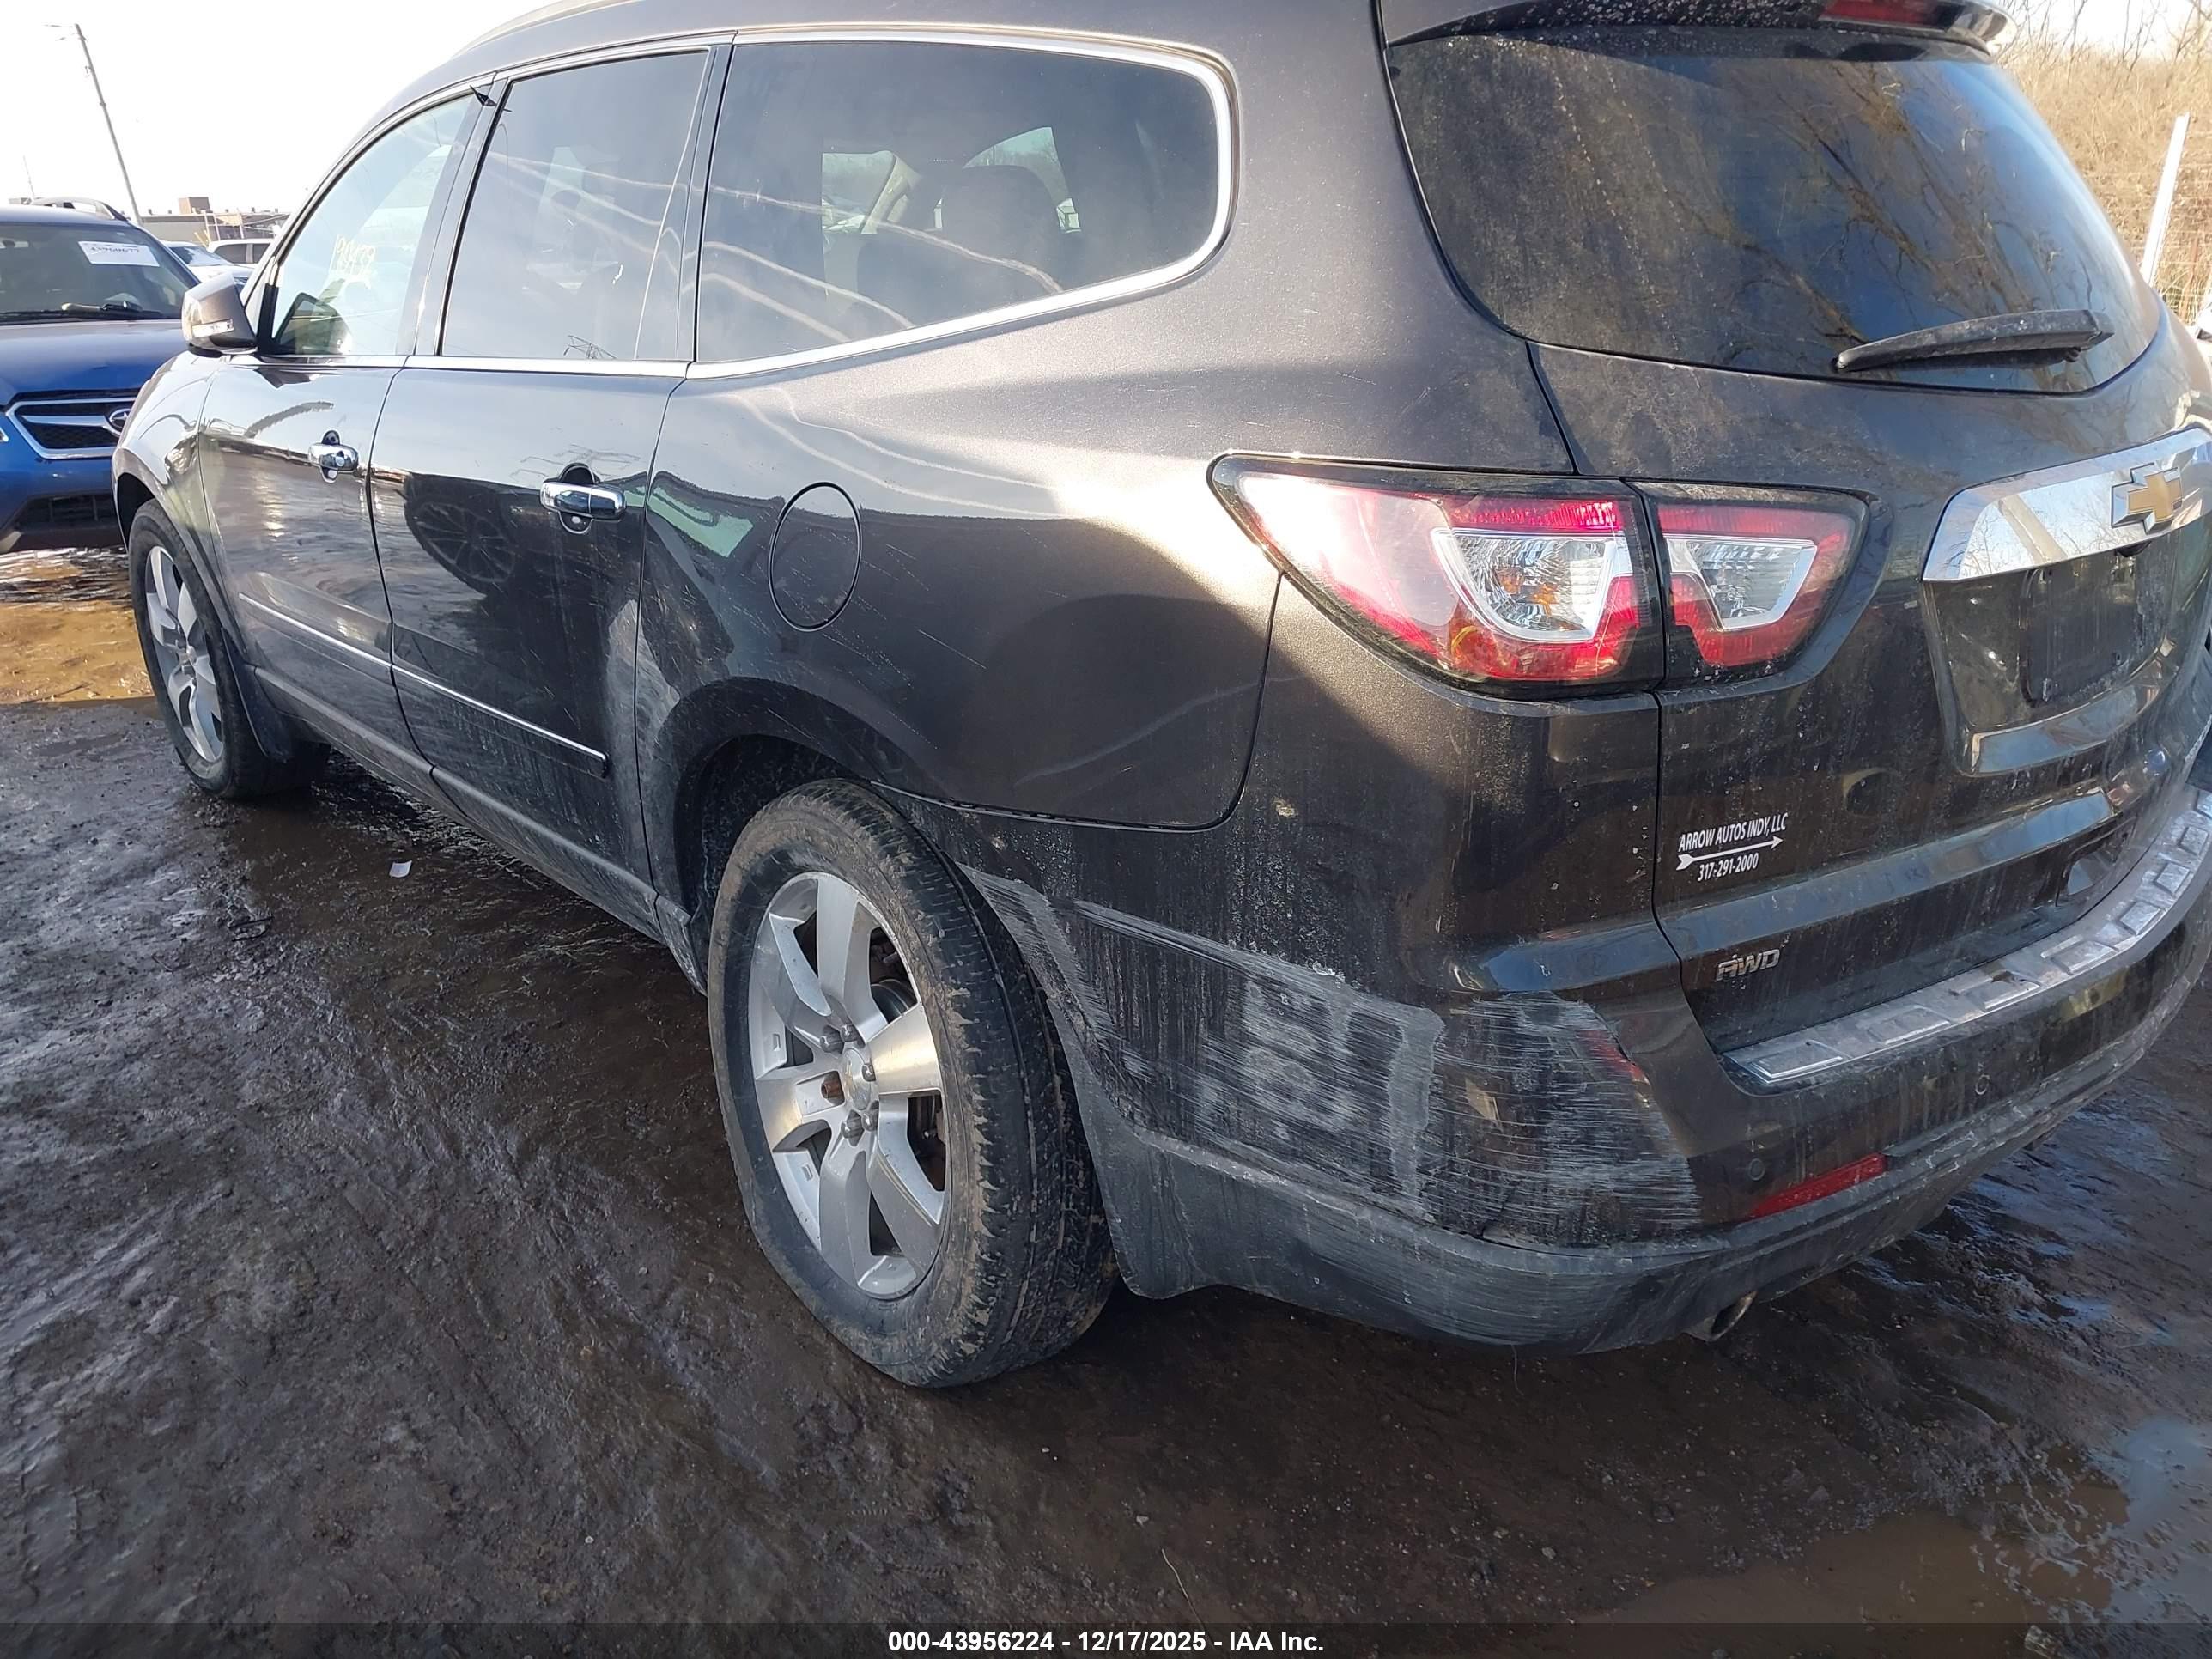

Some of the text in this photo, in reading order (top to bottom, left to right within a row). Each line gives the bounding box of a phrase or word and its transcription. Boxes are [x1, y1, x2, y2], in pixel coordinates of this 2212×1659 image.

[1678, 812, 1788, 852] ARROW AUTOS INDY, LLC
[1698, 852, 1759, 882] 317-291-2000
[1716, 949, 1780, 981] AWD
